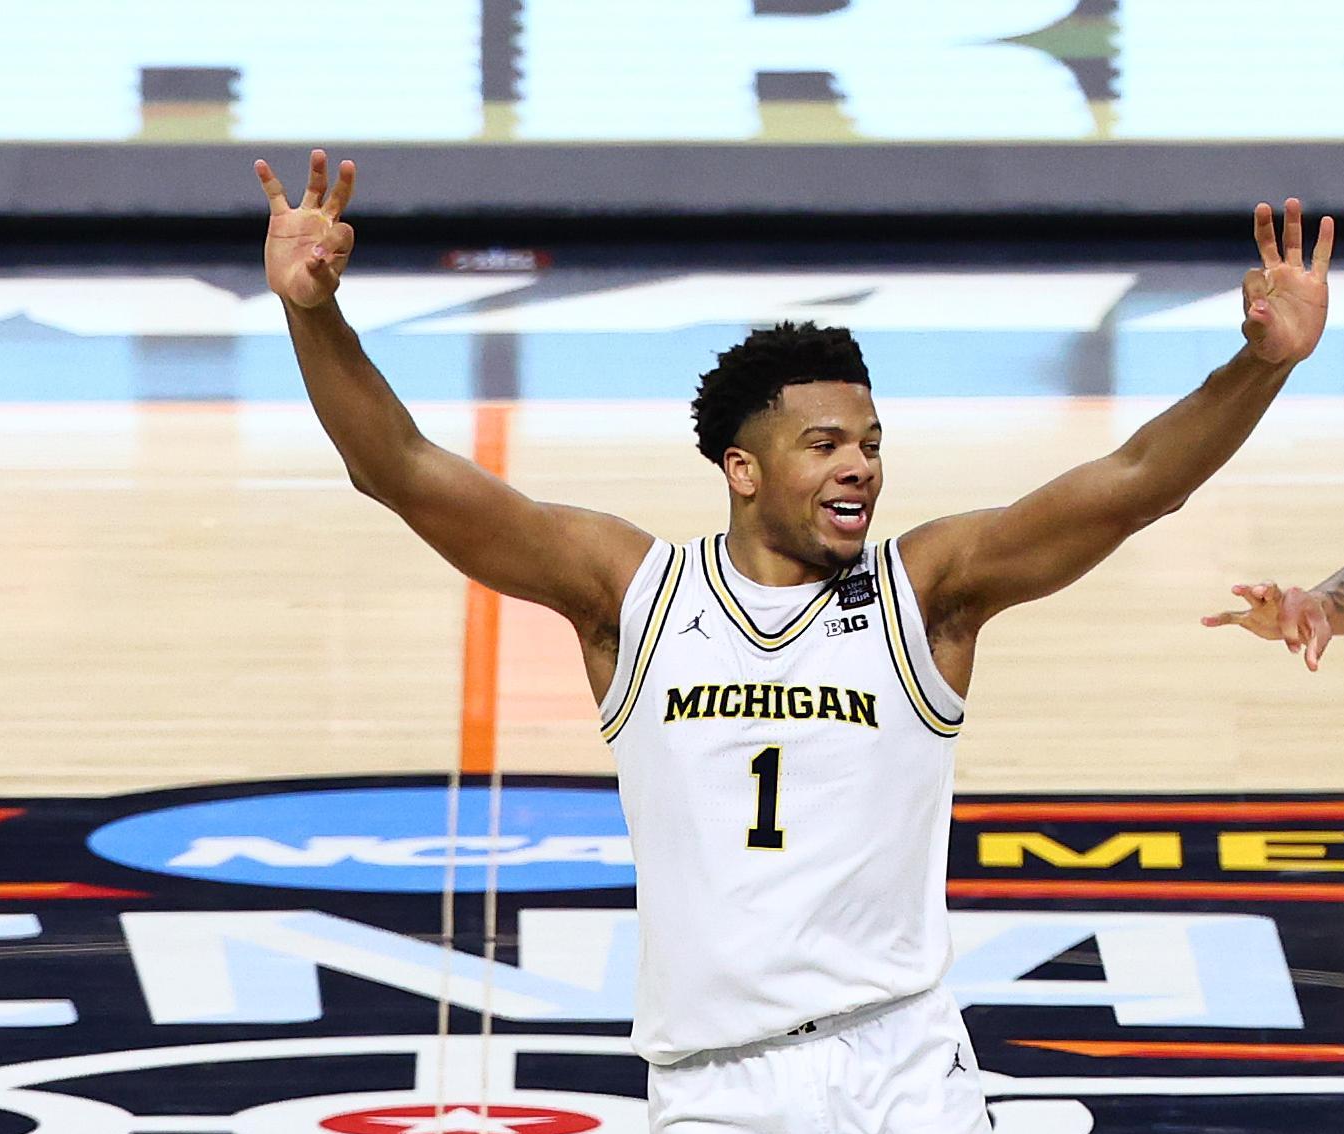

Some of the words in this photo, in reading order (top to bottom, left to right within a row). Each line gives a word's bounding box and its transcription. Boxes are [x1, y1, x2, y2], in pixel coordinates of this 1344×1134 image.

[663, 681, 879, 729] MICHIGAN
[744, 744, 786, 851] 1
[165, 834, 636, 868] NCA
